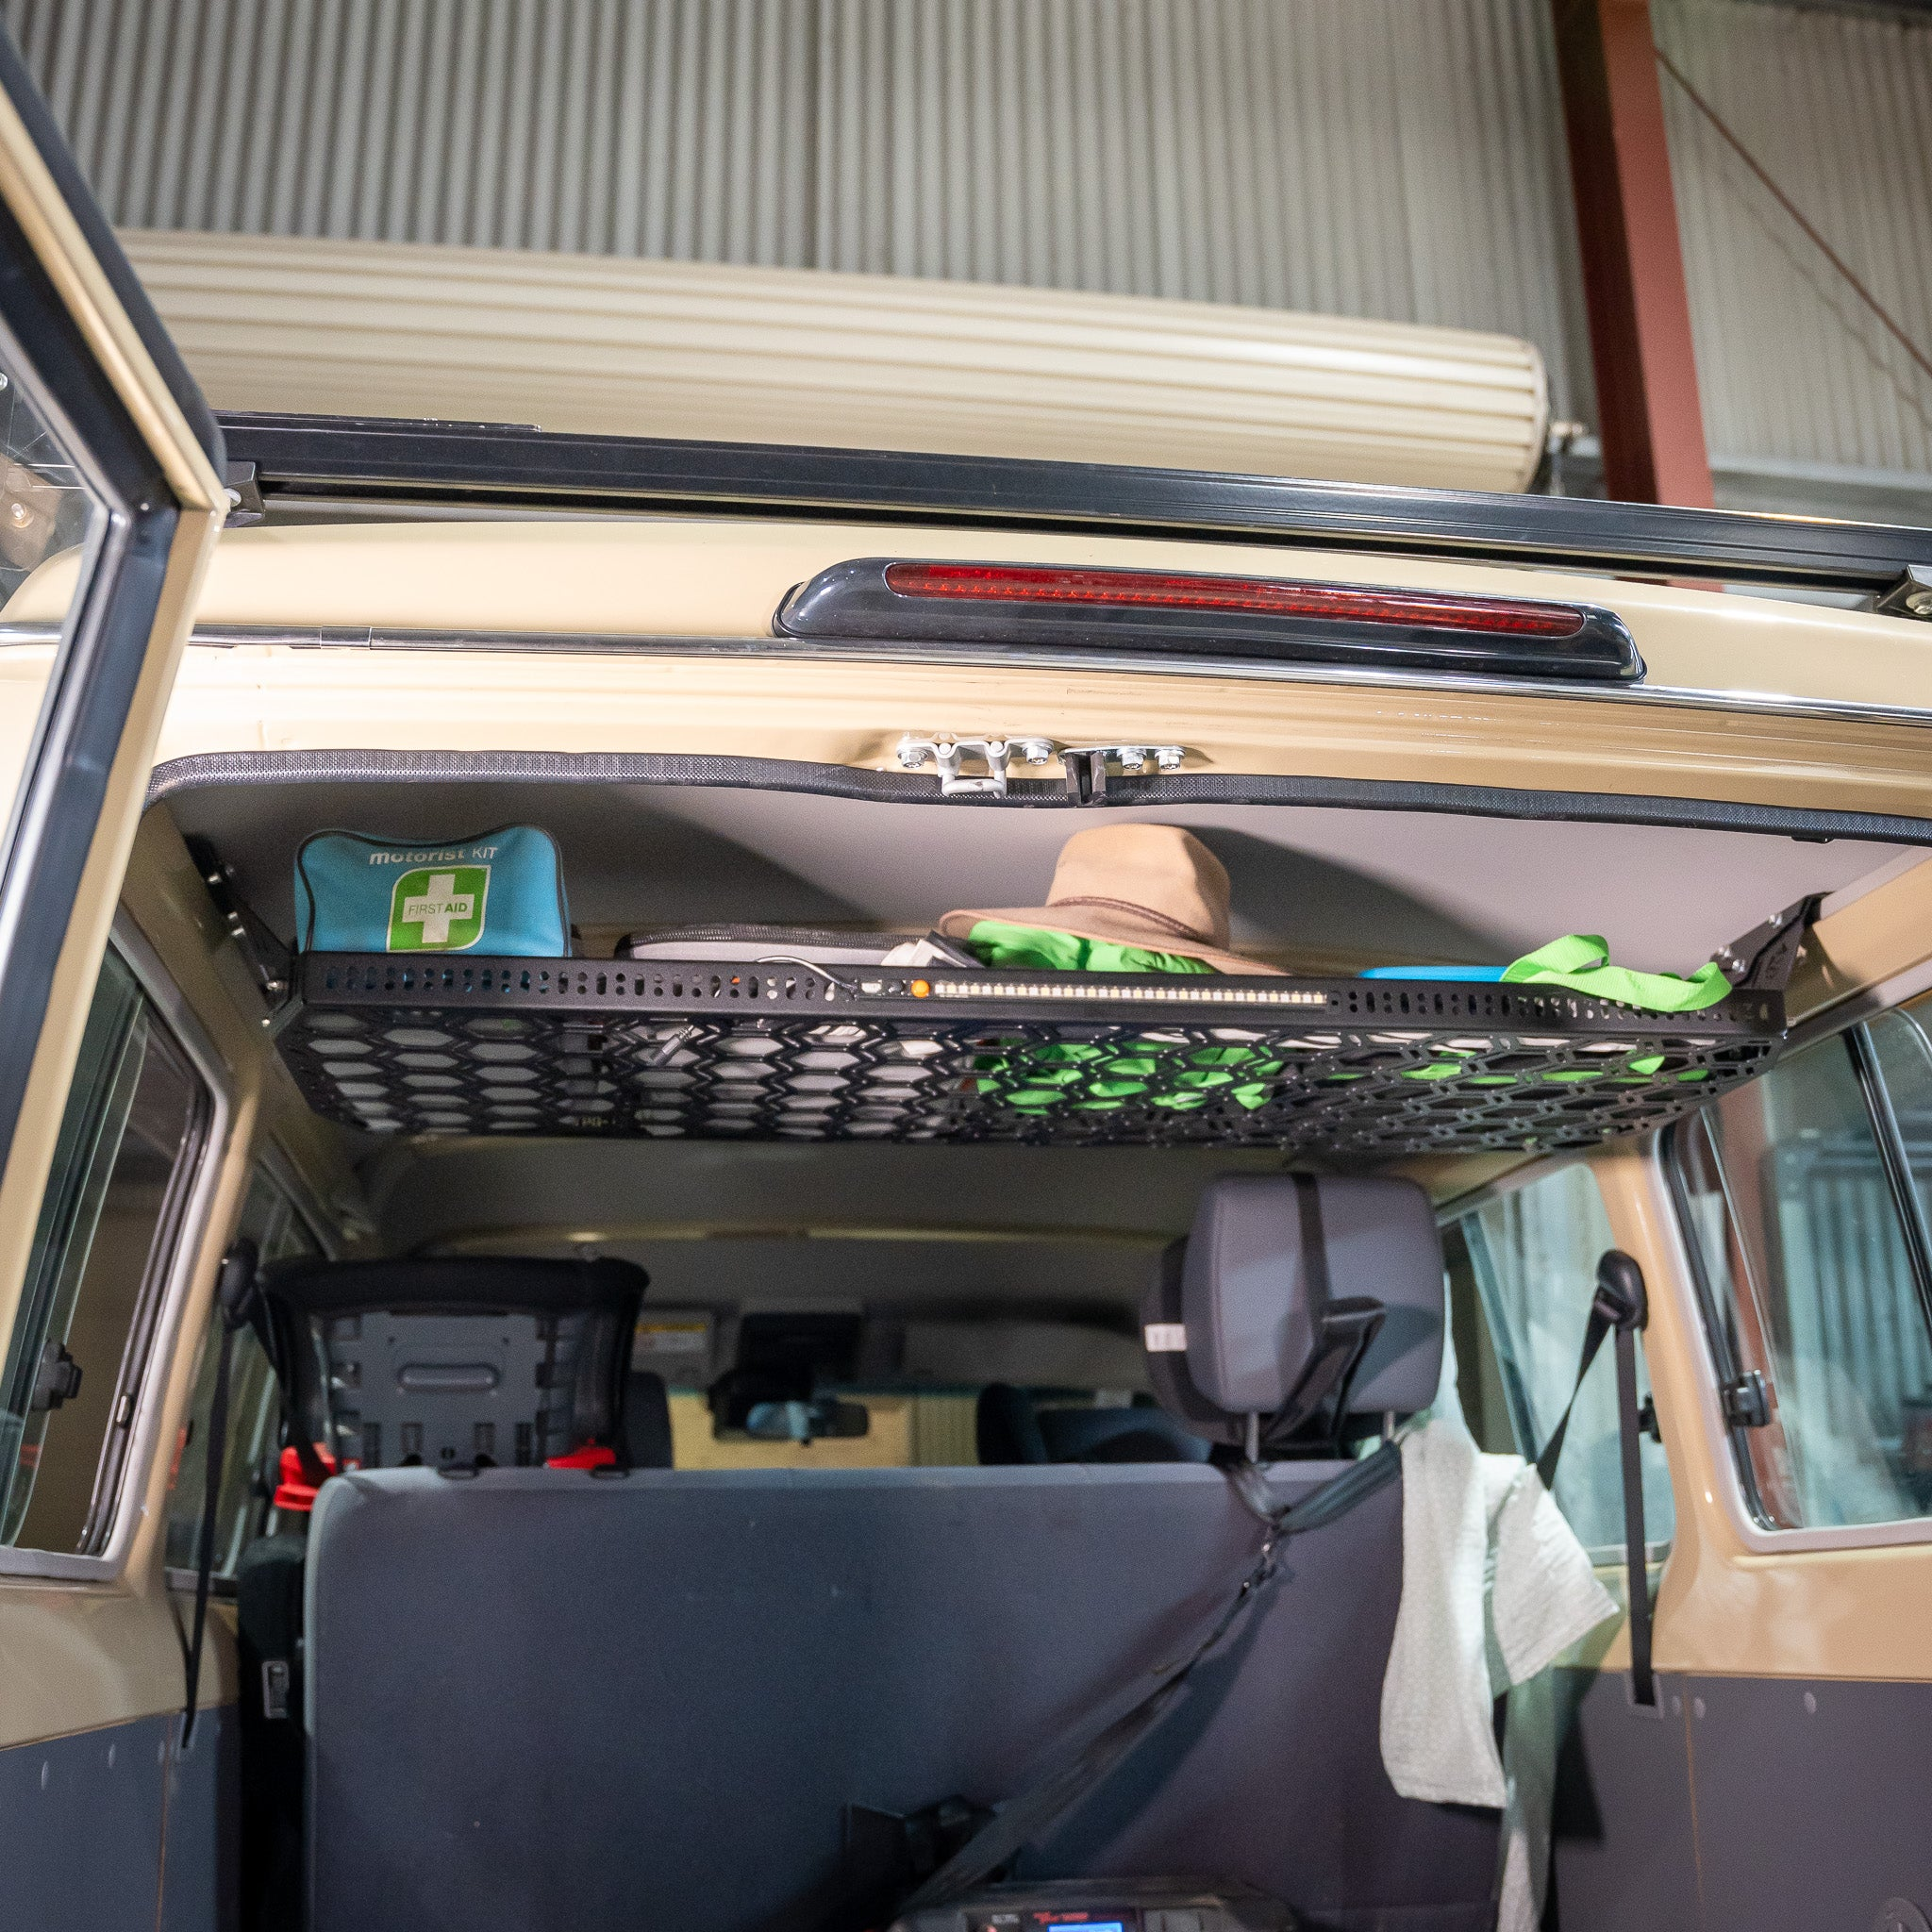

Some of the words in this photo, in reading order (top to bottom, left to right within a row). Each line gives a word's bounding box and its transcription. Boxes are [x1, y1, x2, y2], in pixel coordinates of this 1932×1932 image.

[369, 850, 465, 865] motorist
[472, 847, 498, 859] KIT
[408, 903, 443, 915] FIRST
[444, 902, 468, 913] AID
